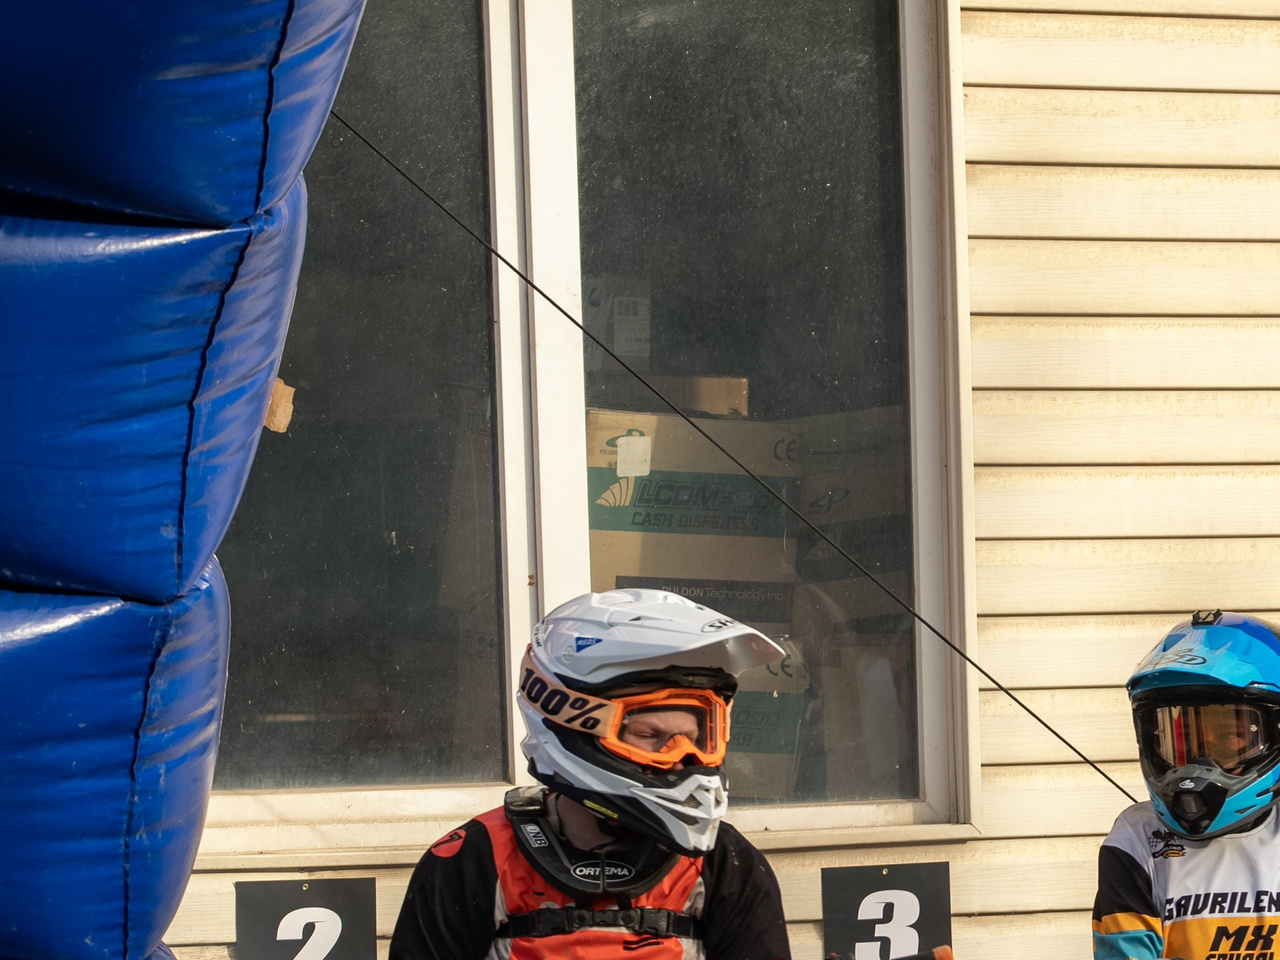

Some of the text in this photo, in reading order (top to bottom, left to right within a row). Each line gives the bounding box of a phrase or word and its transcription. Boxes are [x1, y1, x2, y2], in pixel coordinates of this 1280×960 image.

[631, 512, 673, 526] CASH
[677, 512, 760, 531] DISPENSER
[705, 588, 766, 601] Technology
[520, 667, 608, 730] 100%
[575, 866, 630, 877] ORTEMA
[1209, 924, 1280, 951] MX
